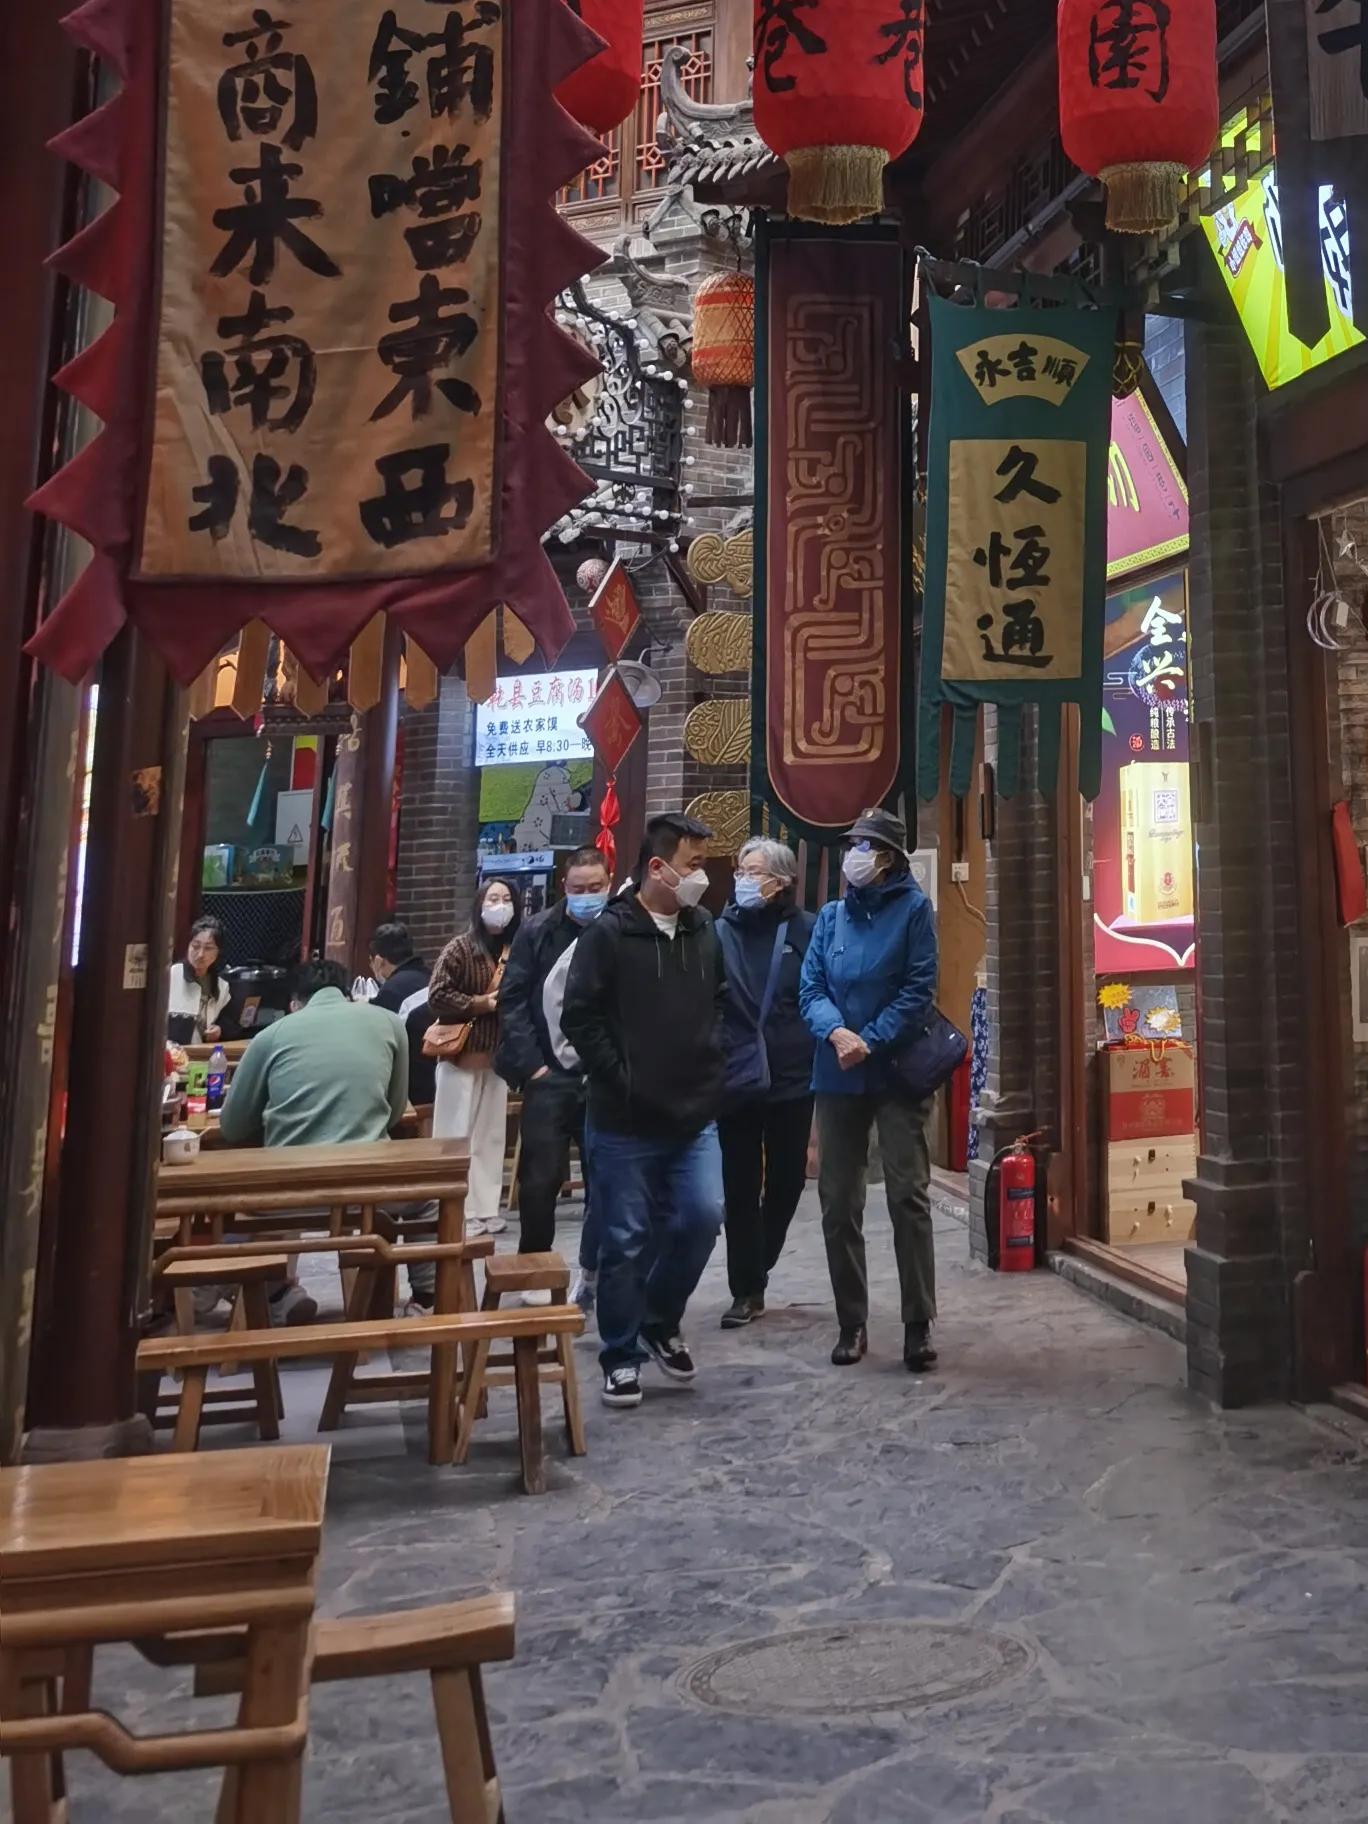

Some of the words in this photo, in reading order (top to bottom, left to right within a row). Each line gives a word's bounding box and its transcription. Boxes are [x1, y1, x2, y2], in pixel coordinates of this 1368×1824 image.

[974, 340, 1079, 390] 永吉順
[485, 740, 529, 759] 全天供应
